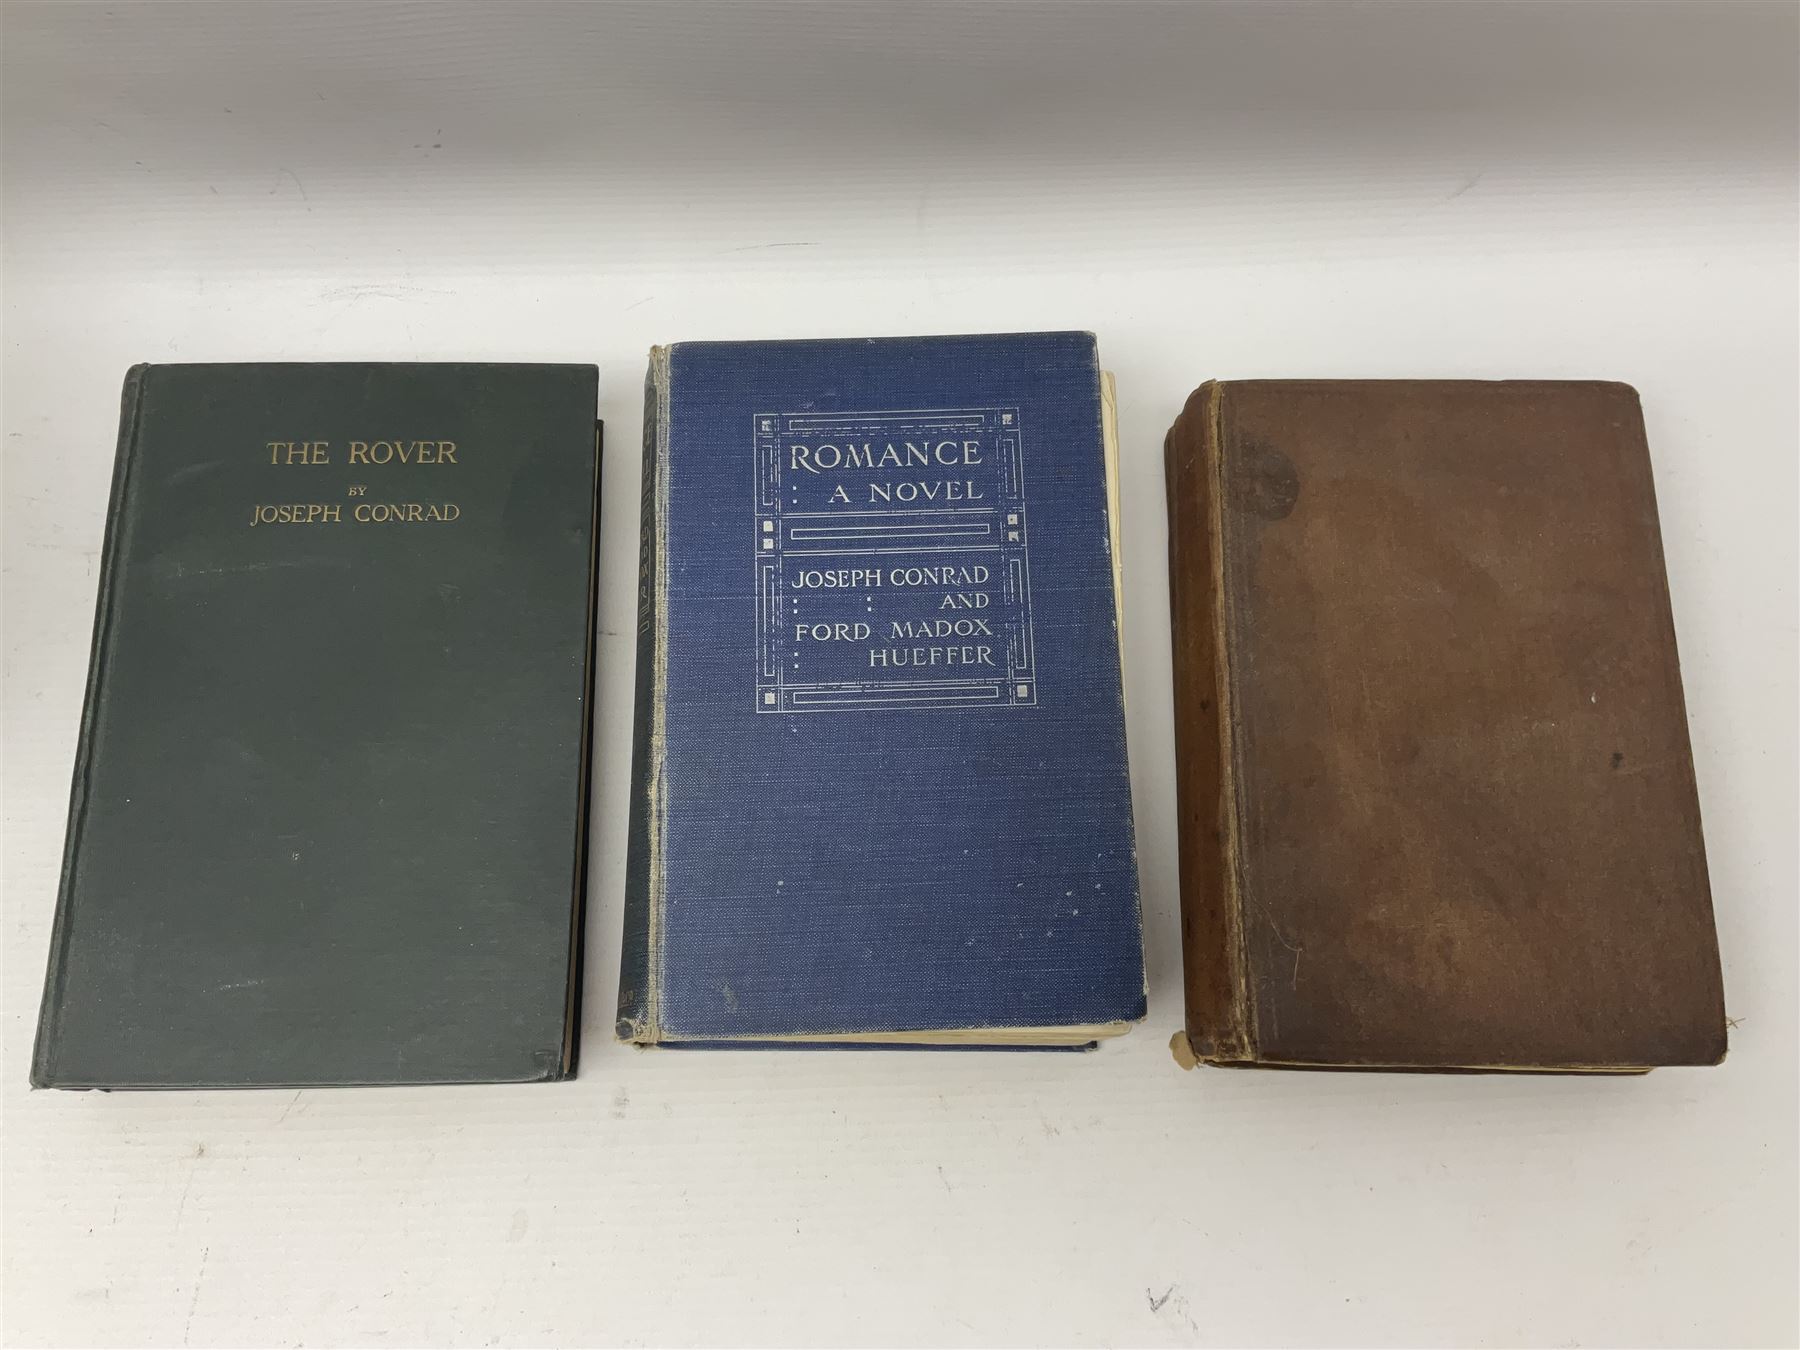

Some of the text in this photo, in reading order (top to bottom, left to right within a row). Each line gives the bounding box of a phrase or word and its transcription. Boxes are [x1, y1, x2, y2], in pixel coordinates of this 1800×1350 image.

[266, 440, 458, 465] THE ROVER
[790, 441, 983, 474] ROMANCE
[348, 486, 367, 496] BY
[828, 481, 984, 503] A NOVEL
[250, 503, 460, 527] JOSEPH CONRAD
[791, 566, 989, 589] JOSEPH CONRAD
[938, 593, 989, 610] AND
[795, 618, 992, 642] FORD MADOX
[869, 645, 996, 667] HUEFFER
